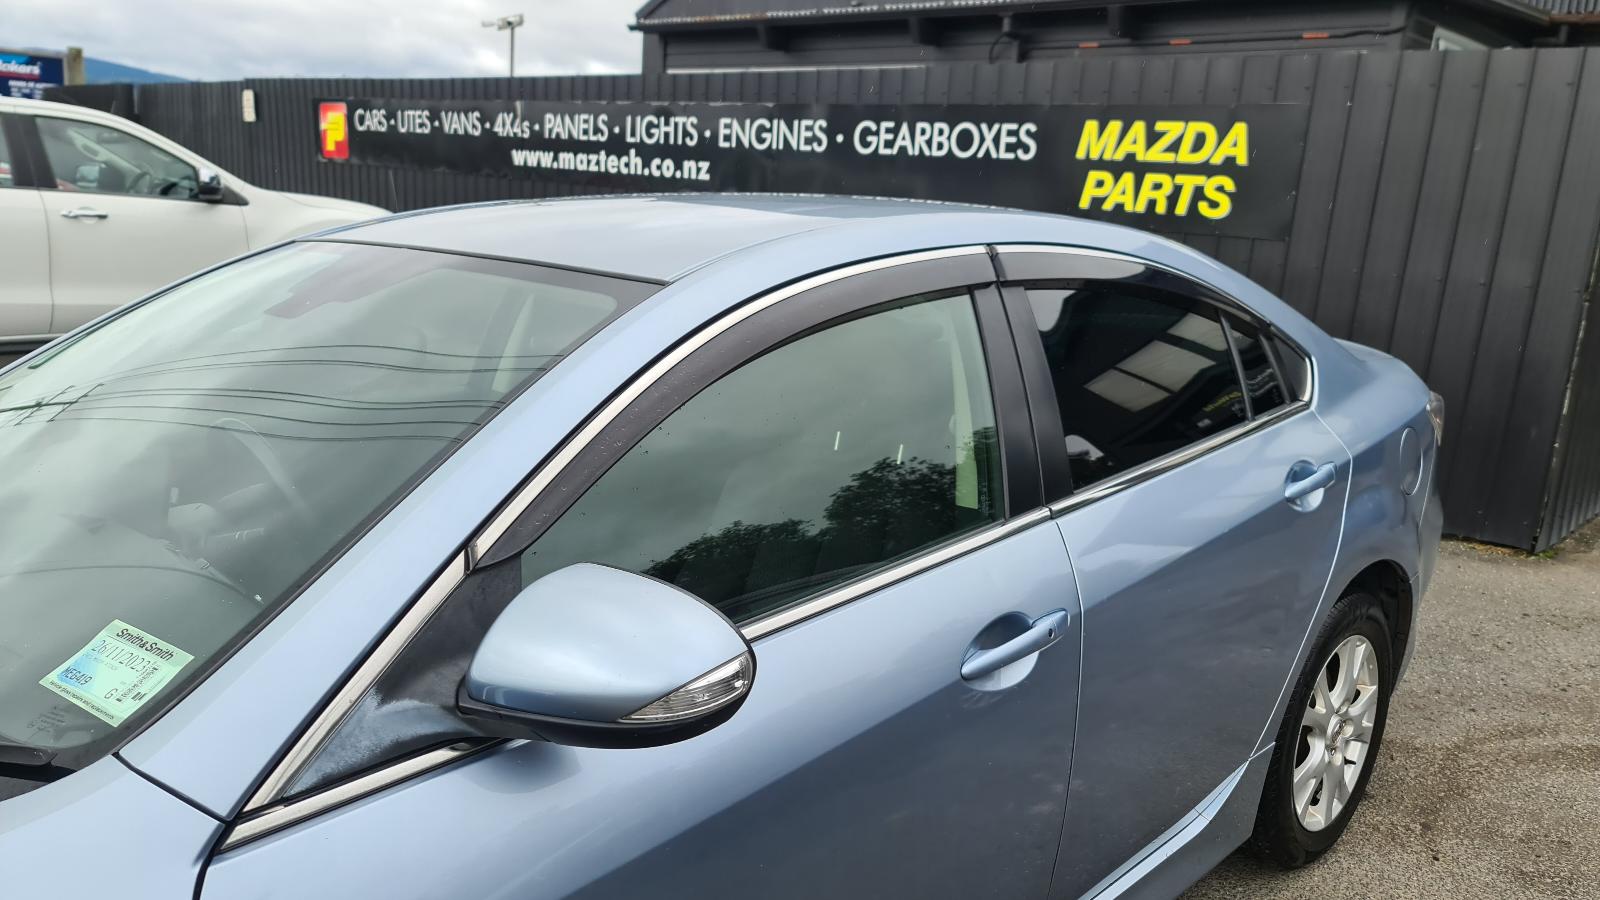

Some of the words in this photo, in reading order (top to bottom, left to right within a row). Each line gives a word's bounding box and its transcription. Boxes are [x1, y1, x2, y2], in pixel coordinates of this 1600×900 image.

[353, 108, 388, 133] CARS
[397, 109, 431, 134] UTES
[440, 110, 482, 137] VANS
[492, 112, 530, 138] 4X4s
[543, 112, 609, 143] PANELS
[625, 114, 699, 147] LIGHTS
[717, 116, 828, 153] ENGINES
[853, 119, 1038, 161] GEARBOXES
[1074, 118, 1249, 167] MAZDA
[511, 148, 711, 182] www.maztech.co.nz
[1077, 169, 1237, 220] PARTS
